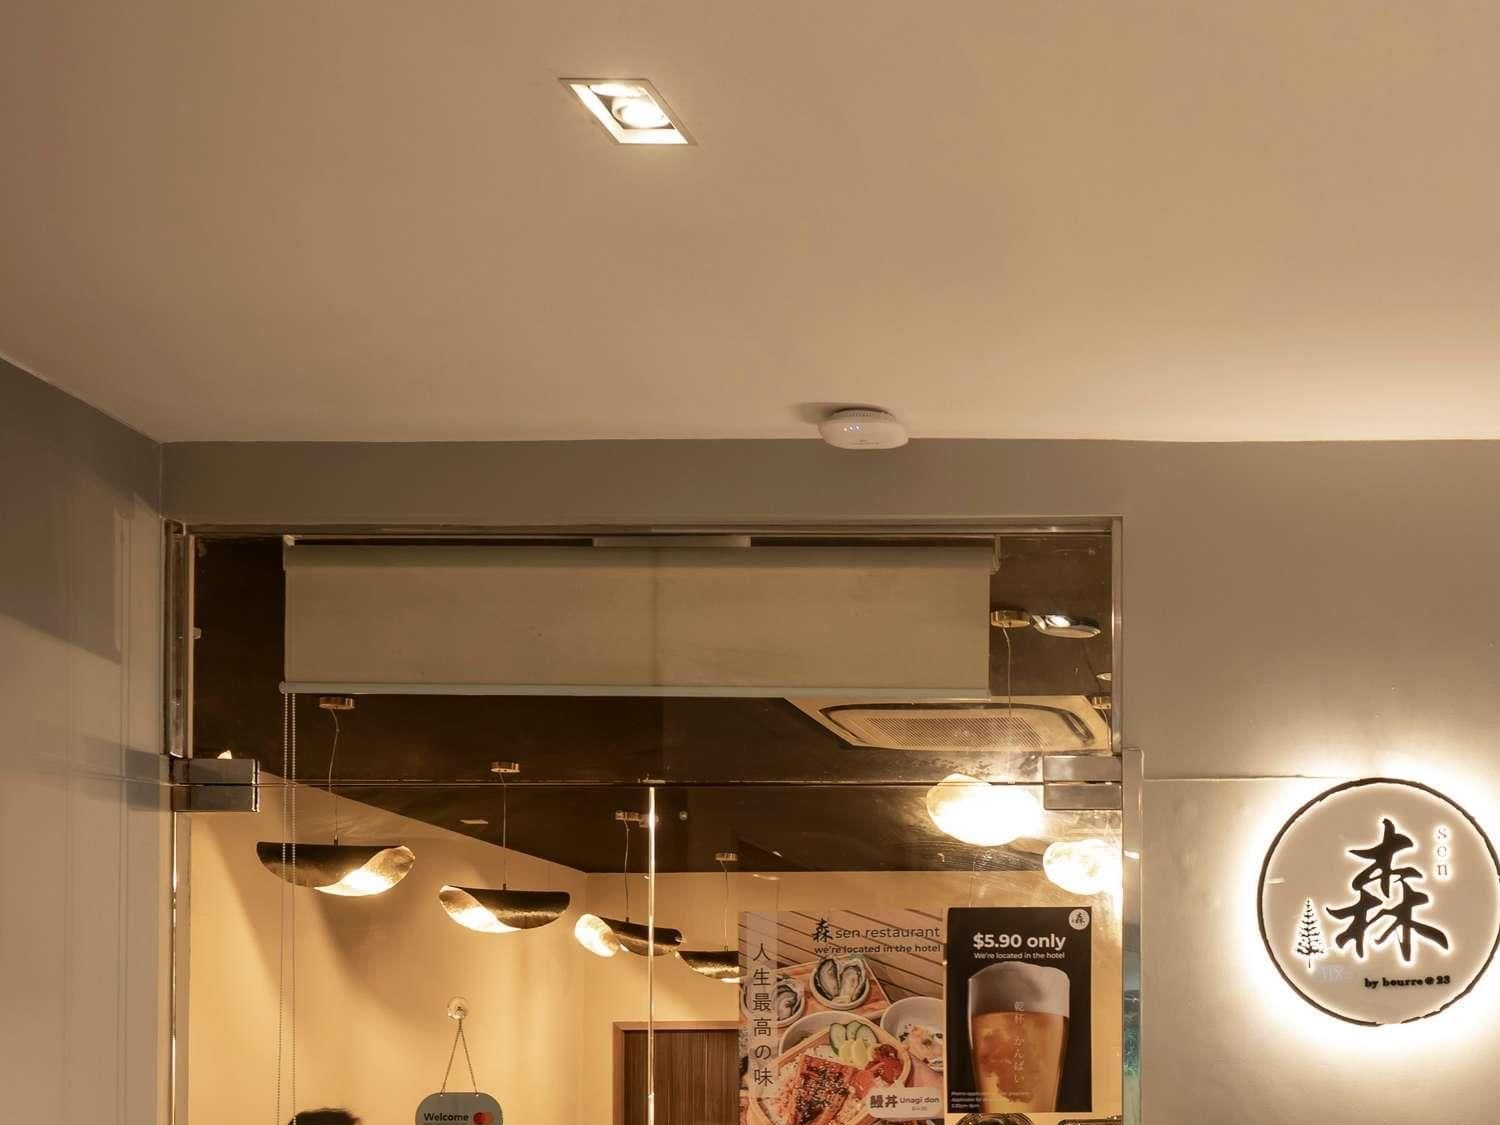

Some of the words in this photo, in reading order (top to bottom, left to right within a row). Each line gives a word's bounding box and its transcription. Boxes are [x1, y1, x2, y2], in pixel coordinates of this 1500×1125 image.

[1435, 827, 1449, 877] sen
[1325, 818, 1449, 962] 森
[835, 929, 862, 939] sen
[864, 927, 940, 938] restaurant
[973, 932, 1023, 949] $5.90
[1026, 933, 1066, 951] only
[814, 945, 842, 954] we're
[843, 944, 881, 954] located
[883, 944, 894, 954] in
[895, 944, 913, 954] the
[914, 943, 941, 953] hotel
[1046, 952, 1066, 960] hotel
[1364, 977, 1379, 989] by
[752, 943, 775, 1087] 人生最高の味
[899, 1096, 923, 1105] Unagi
[924, 1096, 940, 1104] don
[423, 1112, 470, 1122] Welcome
